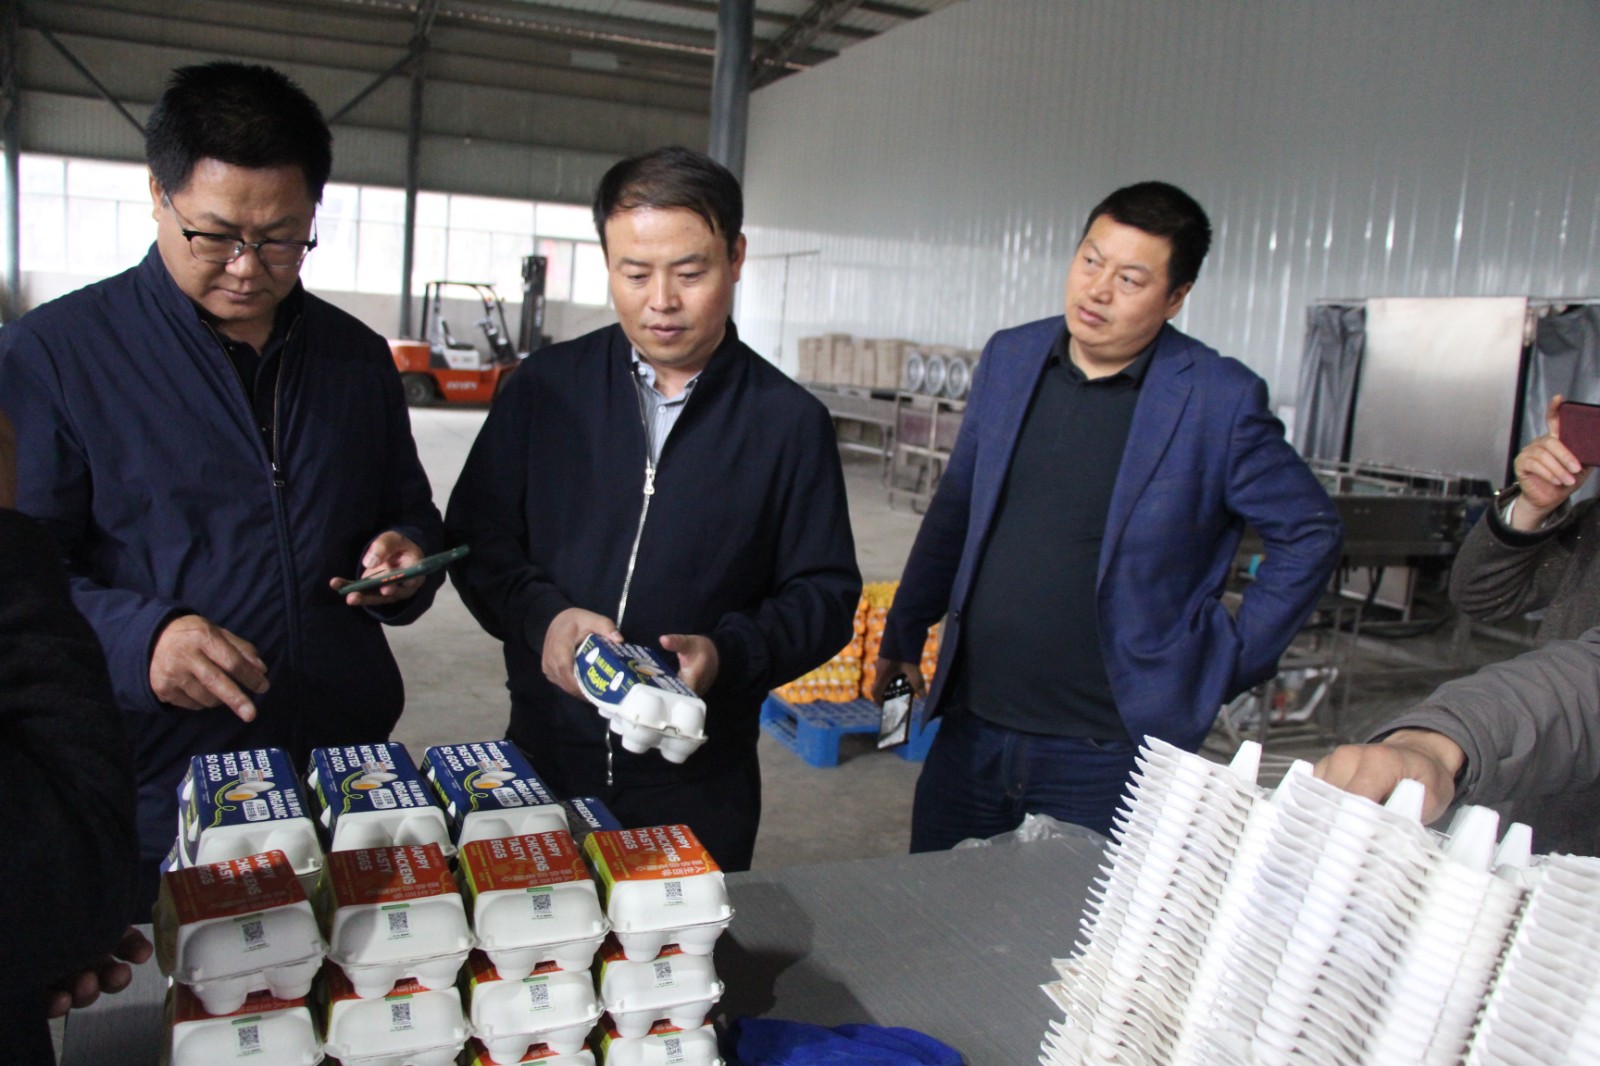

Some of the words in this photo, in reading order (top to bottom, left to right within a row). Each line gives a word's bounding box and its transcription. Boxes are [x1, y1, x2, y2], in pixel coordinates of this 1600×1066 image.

[205, 754, 219, 763] SO
[239, 751, 255, 772] NEVER
[328, 747, 340, 756] SO
[344, 746, 361, 768] TASTED
[359, 745, 377, 763] NEVER
[374, 743, 396, 770] FREEDOM
[440, 746, 454, 755] SO
[456, 745, 477, 767] TASTED
[469, 743, 491, 762] NEVER
[484, 742, 512, 769] FREEDOM
[207, 764, 222, 782] GOOD
[222, 752, 239, 776] TASTED
[254, 749, 274, 778] FREEDOM
[331, 756, 347, 773] GOOD
[445, 755, 465, 772] GOOD
[391, 781, 415, 808] ORGANIC
[511, 779, 540, 805] ORGANIC
[267, 790, 288, 819] ORGANIC
[571, 799, 602, 828] FREEDOM
[541, 832, 563, 857] HAPPY
[620, 830, 639, 850] EGGS
[636, 829, 657, 852] TASTY
[652, 827, 681, 863] CHICKENS
[668, 825, 692, 849] HAPPY
[356, 850, 373, 871] EGGS
[374, 848, 394, 873] TASTY
[490, 840, 508, 859] EGGS
[507, 838, 528, 861] TASTY
[524, 835, 550, 872] CHICKENS
[392, 847, 416, 885] CHICKENS
